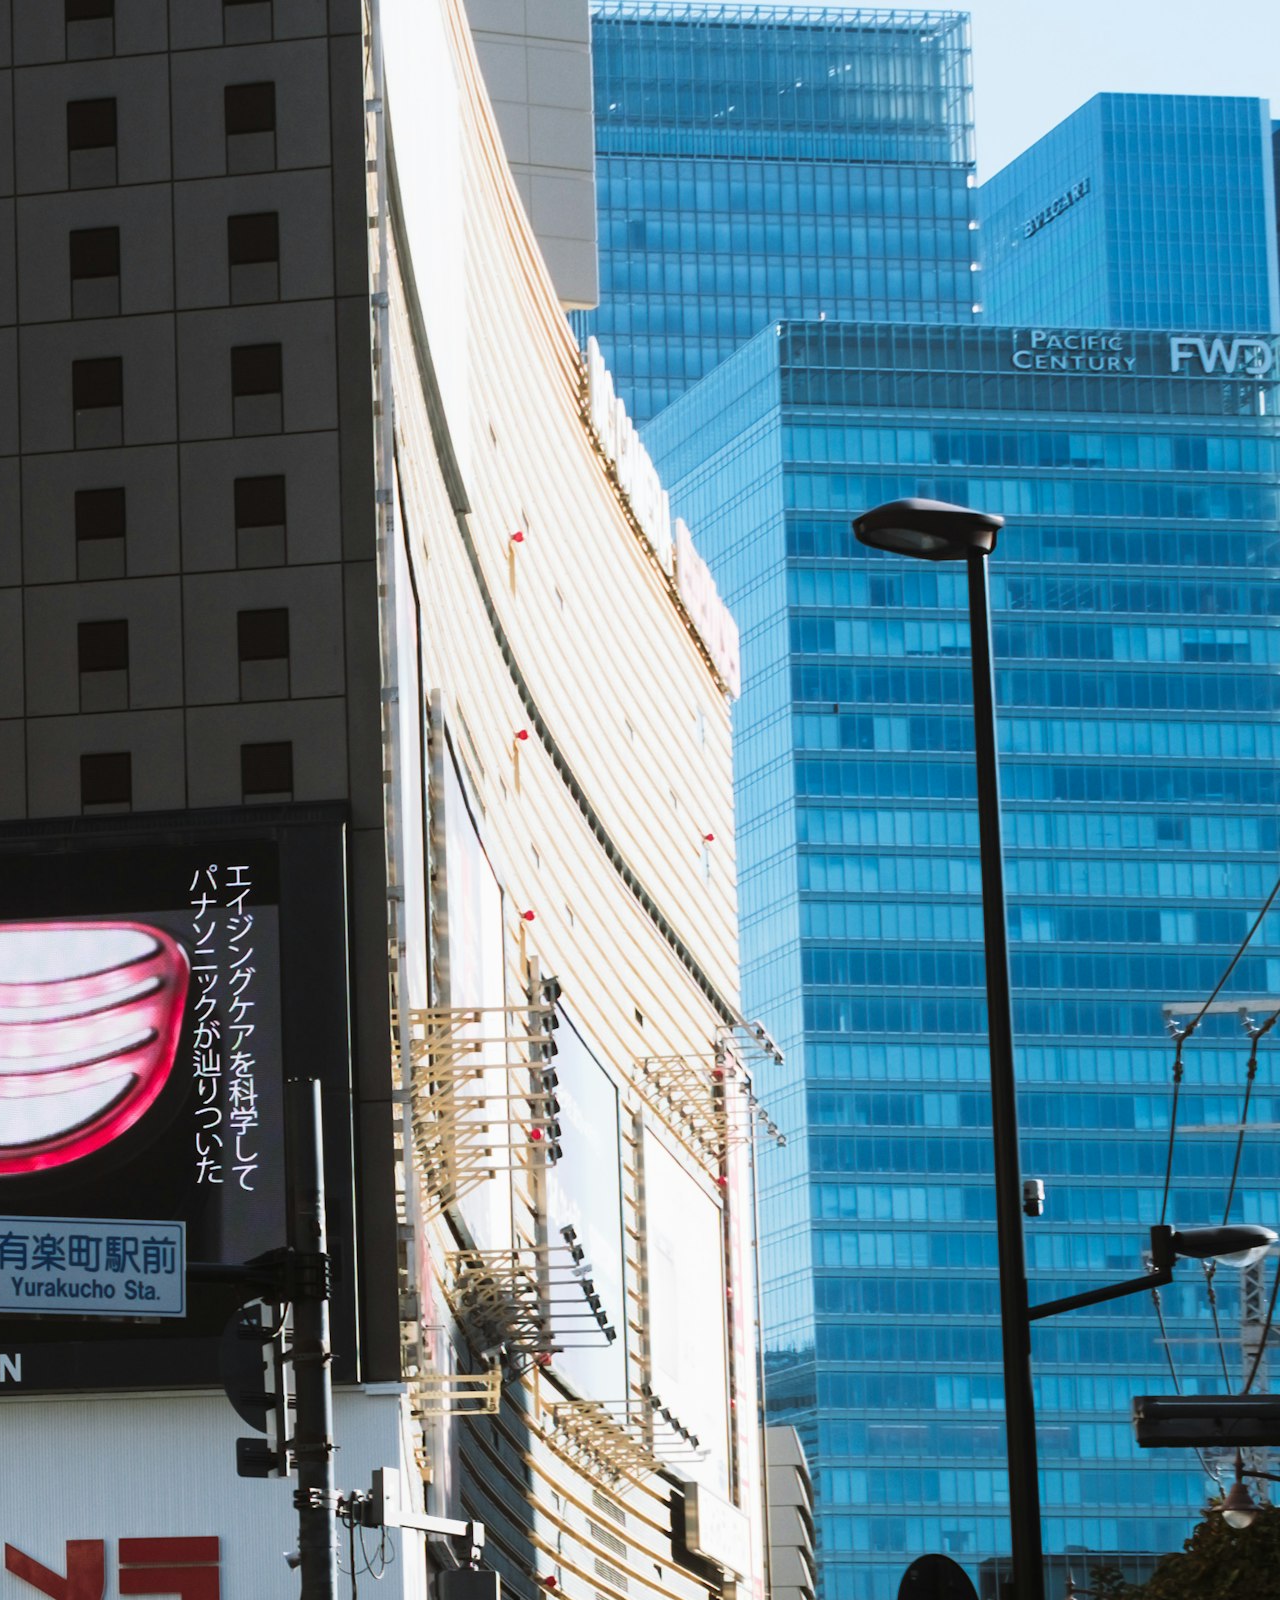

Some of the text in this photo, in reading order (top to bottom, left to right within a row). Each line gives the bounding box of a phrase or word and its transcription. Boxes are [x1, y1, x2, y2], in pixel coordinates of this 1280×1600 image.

[1169, 337, 1273, 374] FWD
[190, 864, 225, 1184] パナソニックが辿りついた
[225, 865, 259, 1192] エイジングケアを科学して
[11, 1276, 161, 1301] Yurakucho Sta.
